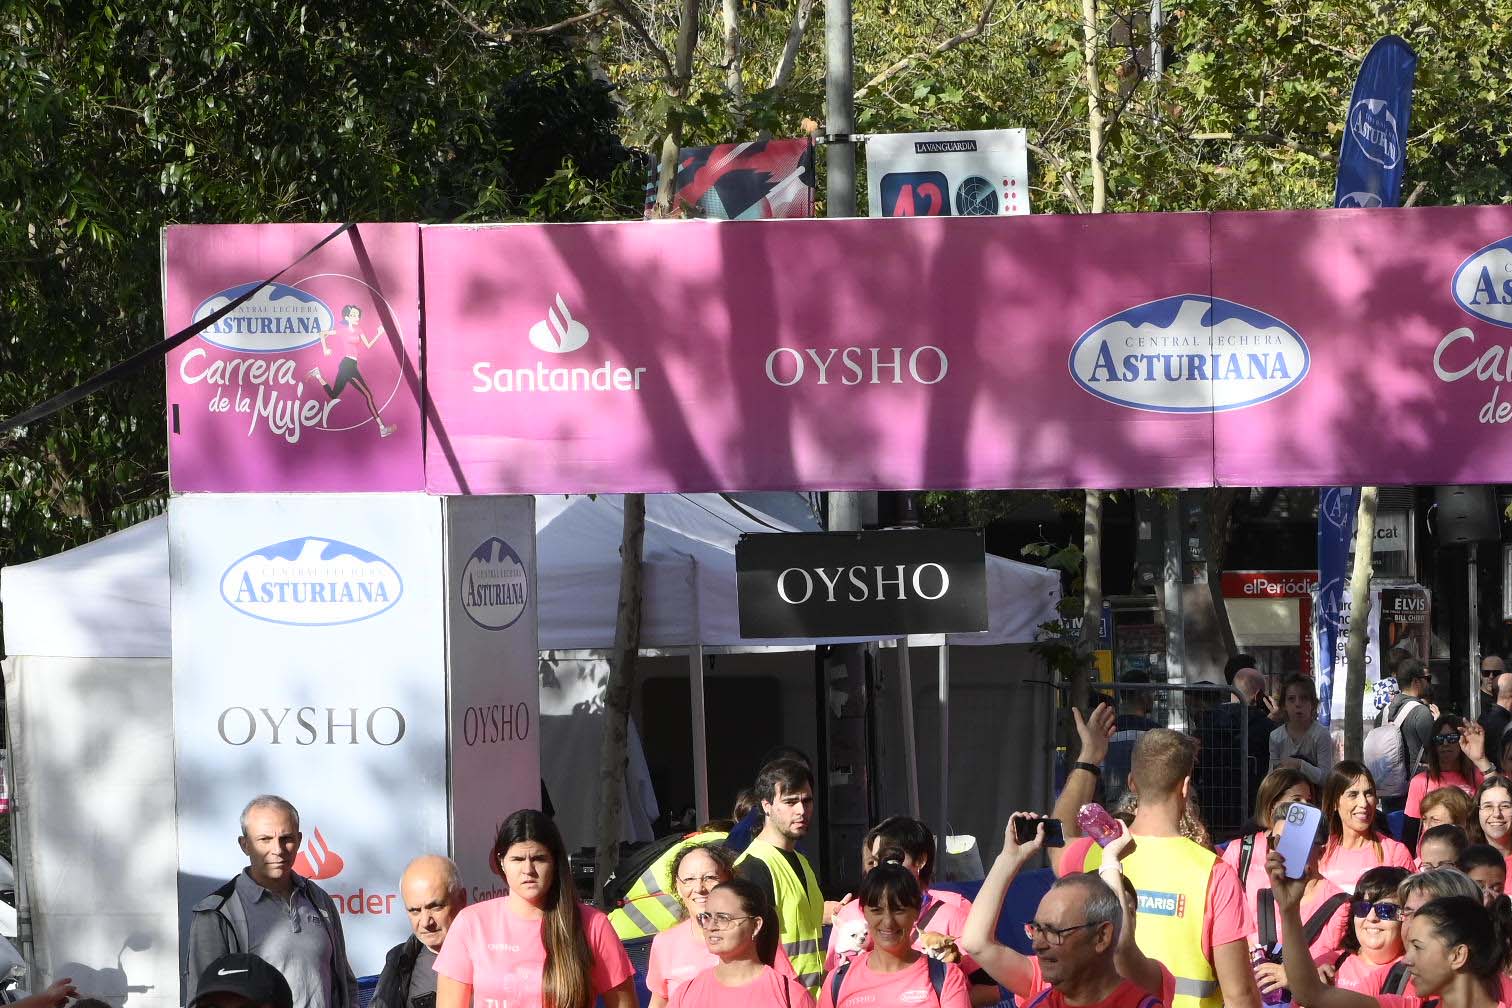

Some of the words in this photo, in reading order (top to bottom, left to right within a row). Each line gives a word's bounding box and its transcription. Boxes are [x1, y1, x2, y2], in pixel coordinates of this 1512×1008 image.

[203, 307, 322, 334] ASTURIANA
[231, 306, 268, 314] ENTRAL
[273, 305, 318, 313] LECHERA
[1124, 335, 1200, 348] CENTRAL
[1207, 334, 1284, 347] LECHERA
[179, 348, 297, 385] Carrera
[472, 361, 647, 393] Santander
[764, 345, 949, 387] OYSHO
[1087, 339, 1293, 383] ASTURIANA
[209, 387, 230, 413] de
[235, 385, 251, 413] la
[248, 384, 342, 443] Mujer
[1478, 385, 1512, 424] de
[237, 571, 389, 604] ASTURIANA
[466, 573, 525, 607] ASTURIANA
[776, 563, 950, 605] OYSHO
[1244, 578, 1316, 594] elPeriódi
[1395, 599, 1425, 611] ELVIS
[217, 706, 406, 745] OYSHO
[464, 702, 529, 745] OYSHO
